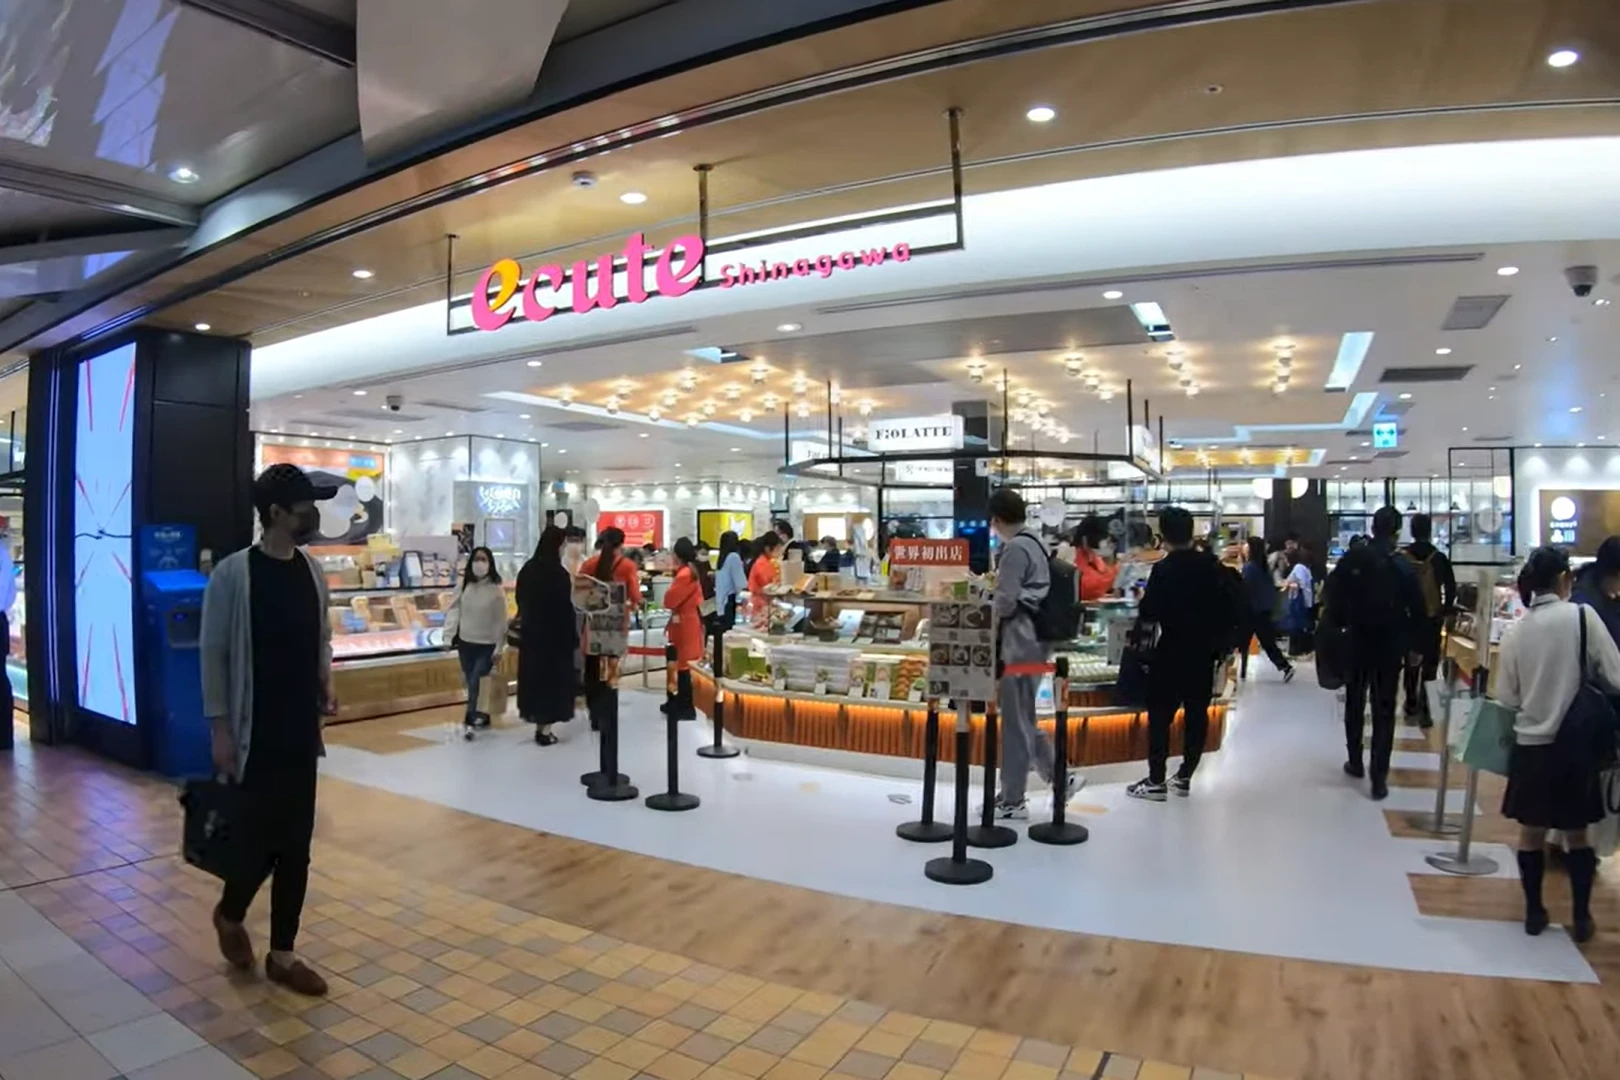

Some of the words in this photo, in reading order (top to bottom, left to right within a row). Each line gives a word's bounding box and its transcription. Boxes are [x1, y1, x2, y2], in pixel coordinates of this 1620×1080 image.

[471, 232, 706, 331] ecute
[719, 241, 911, 289] Shinagawa
[894, 545, 963, 561] 世界初出店
